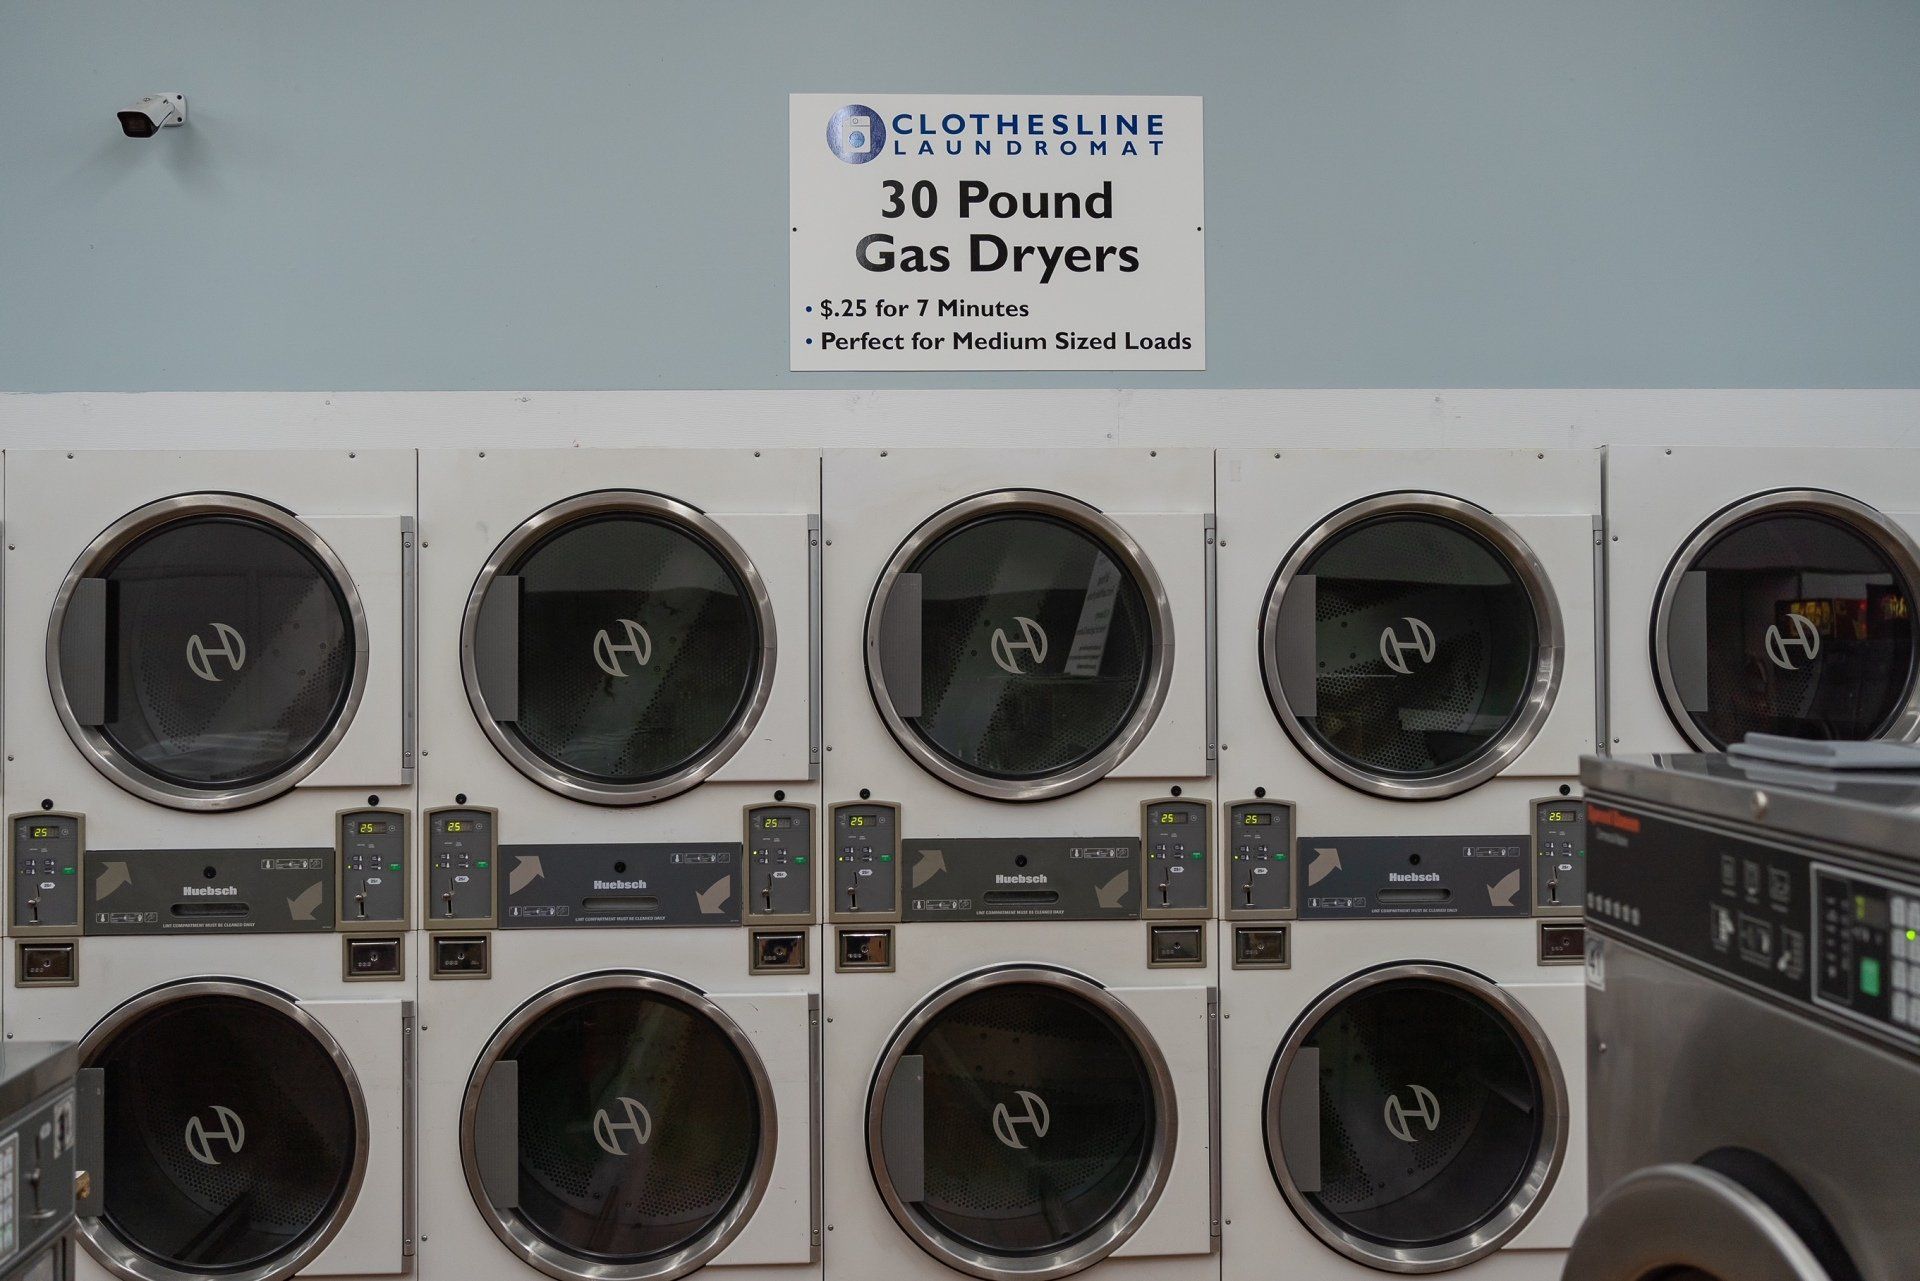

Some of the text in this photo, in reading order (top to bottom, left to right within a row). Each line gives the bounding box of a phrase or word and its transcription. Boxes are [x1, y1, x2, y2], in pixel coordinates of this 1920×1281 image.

[893, 114, 1163, 135] CLOTHESLINE
[895, 141, 1163, 155] LAUNDROMAT
[882, 180, 1112, 218] 30 Pound
[856, 234, 1139, 284] Gas Dryers
[821, 299, 1029, 319] $.25 for 7 Minutes
[822, 332, 1191, 349] Perfect for Medium Sized Loads
[850, 816, 863, 826] 25
[1161, 813, 1174, 823] 25
[1245, 815, 1258, 824] 25
[1549, 812, 1561, 821] 25
[360, 824, 373, 833] 25
[447, 822, 461, 831] 25
[764, 819, 778, 828] 25
[34, 828, 47, 837] 25
[995, 874, 1048, 884] Huebsch
[1389, 872, 1440, 882] Huebsch
[593, 880, 647, 890] Huebsch
[183, 886, 238, 896] Huebsch
